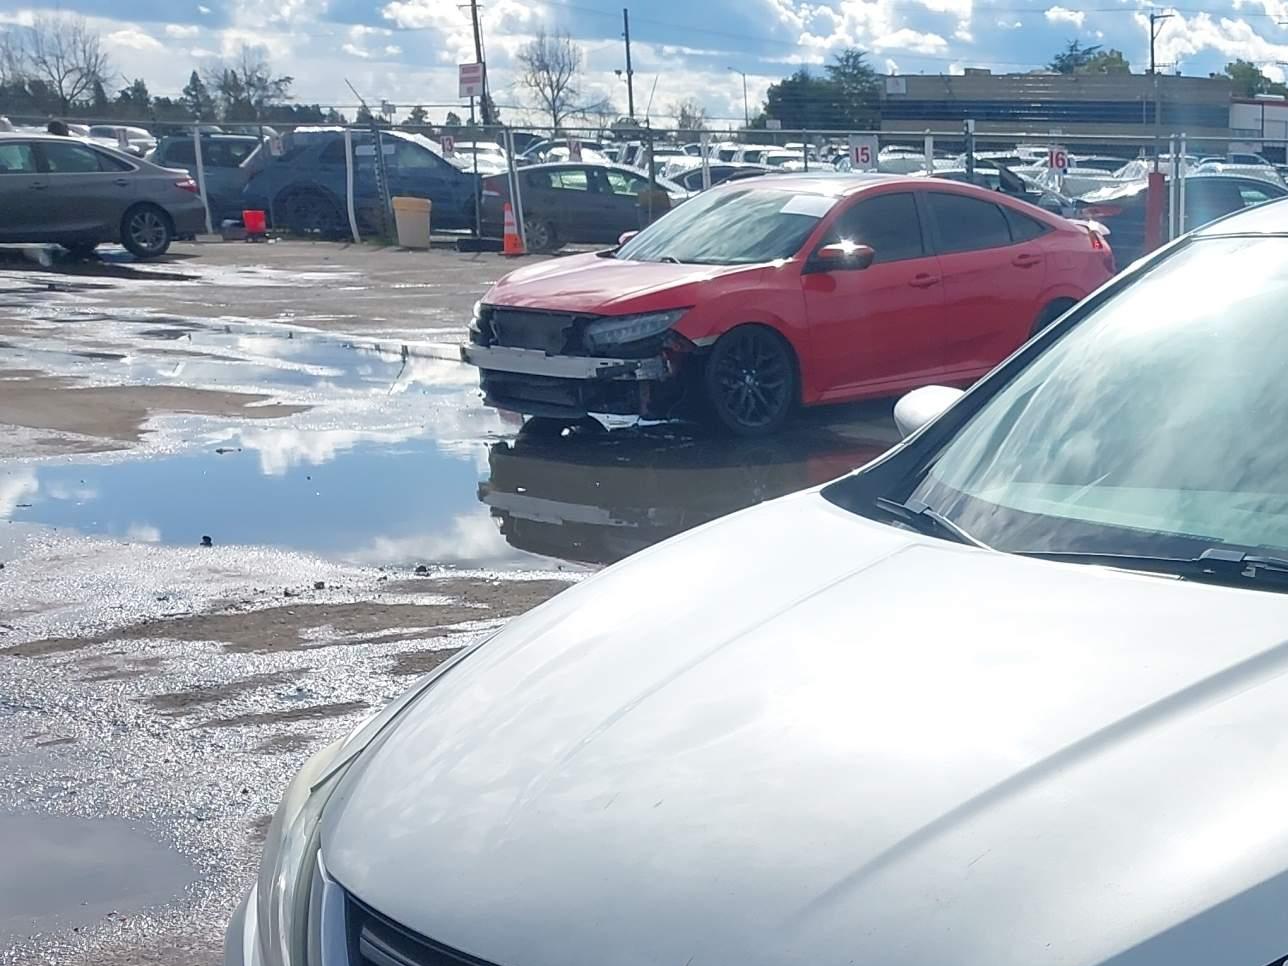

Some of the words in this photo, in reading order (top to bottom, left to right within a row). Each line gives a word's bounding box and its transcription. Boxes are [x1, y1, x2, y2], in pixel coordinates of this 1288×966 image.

[441, 137, 454, 153] 13
[855, 146, 870, 164] 15
[1050, 151, 1066, 168] 16
